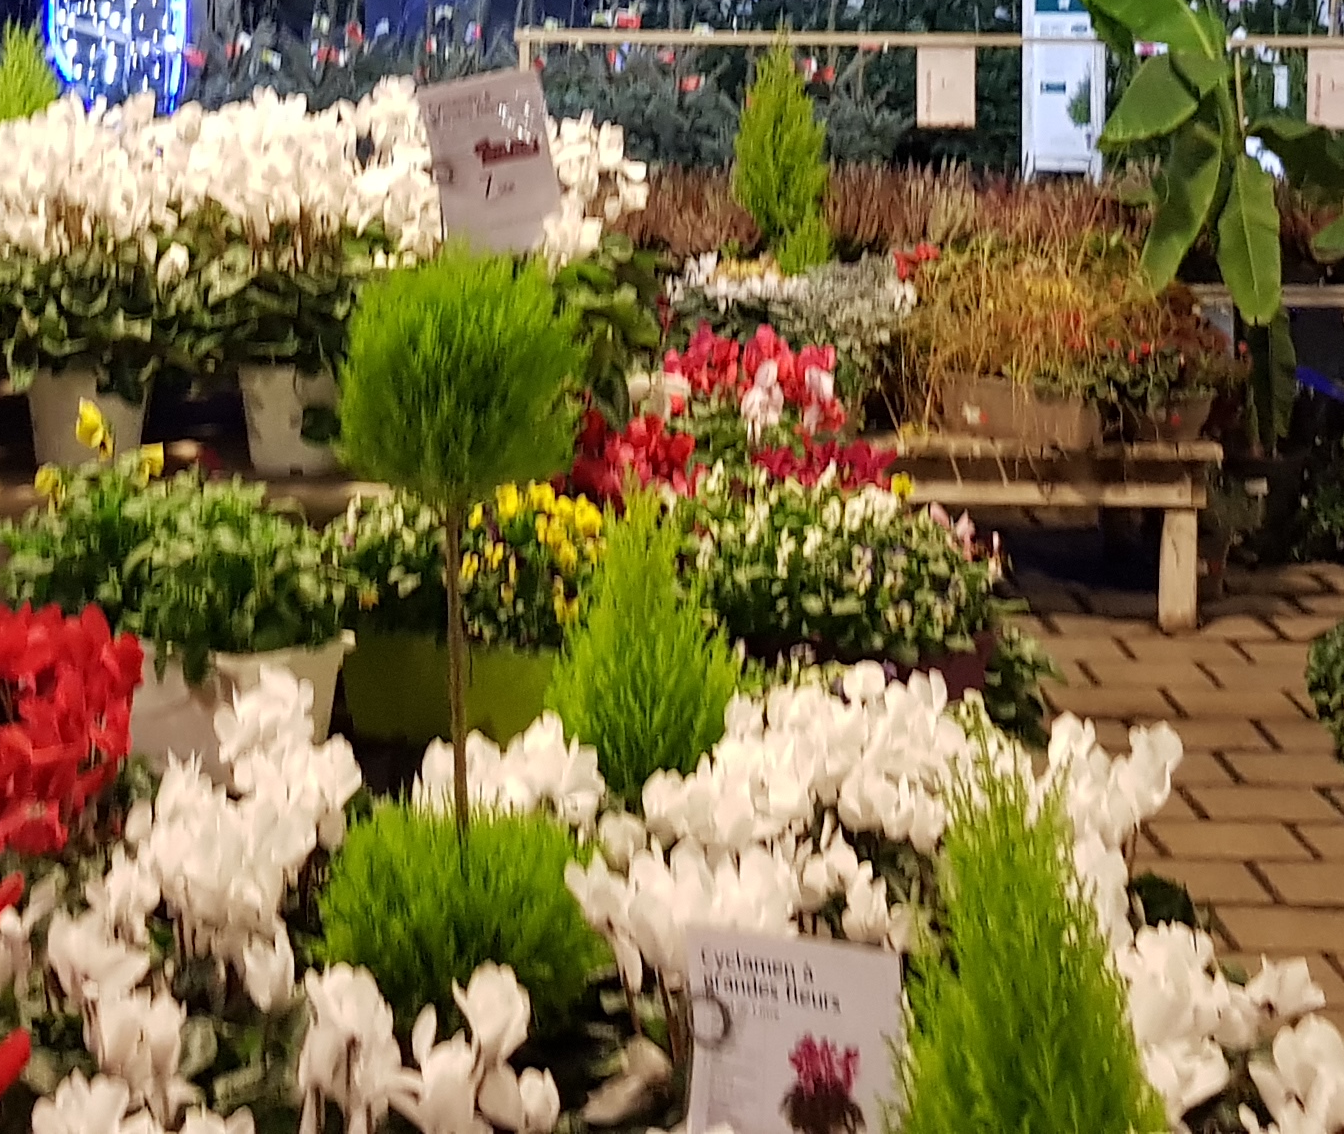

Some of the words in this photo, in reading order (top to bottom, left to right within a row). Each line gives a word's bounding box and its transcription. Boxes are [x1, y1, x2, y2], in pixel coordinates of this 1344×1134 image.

[700, 945, 796, 978] Cyclamen
[803, 958, 815, 985] à
[703, 973, 778, 1005] grandes
[785, 979, 842, 1015] fleurs
